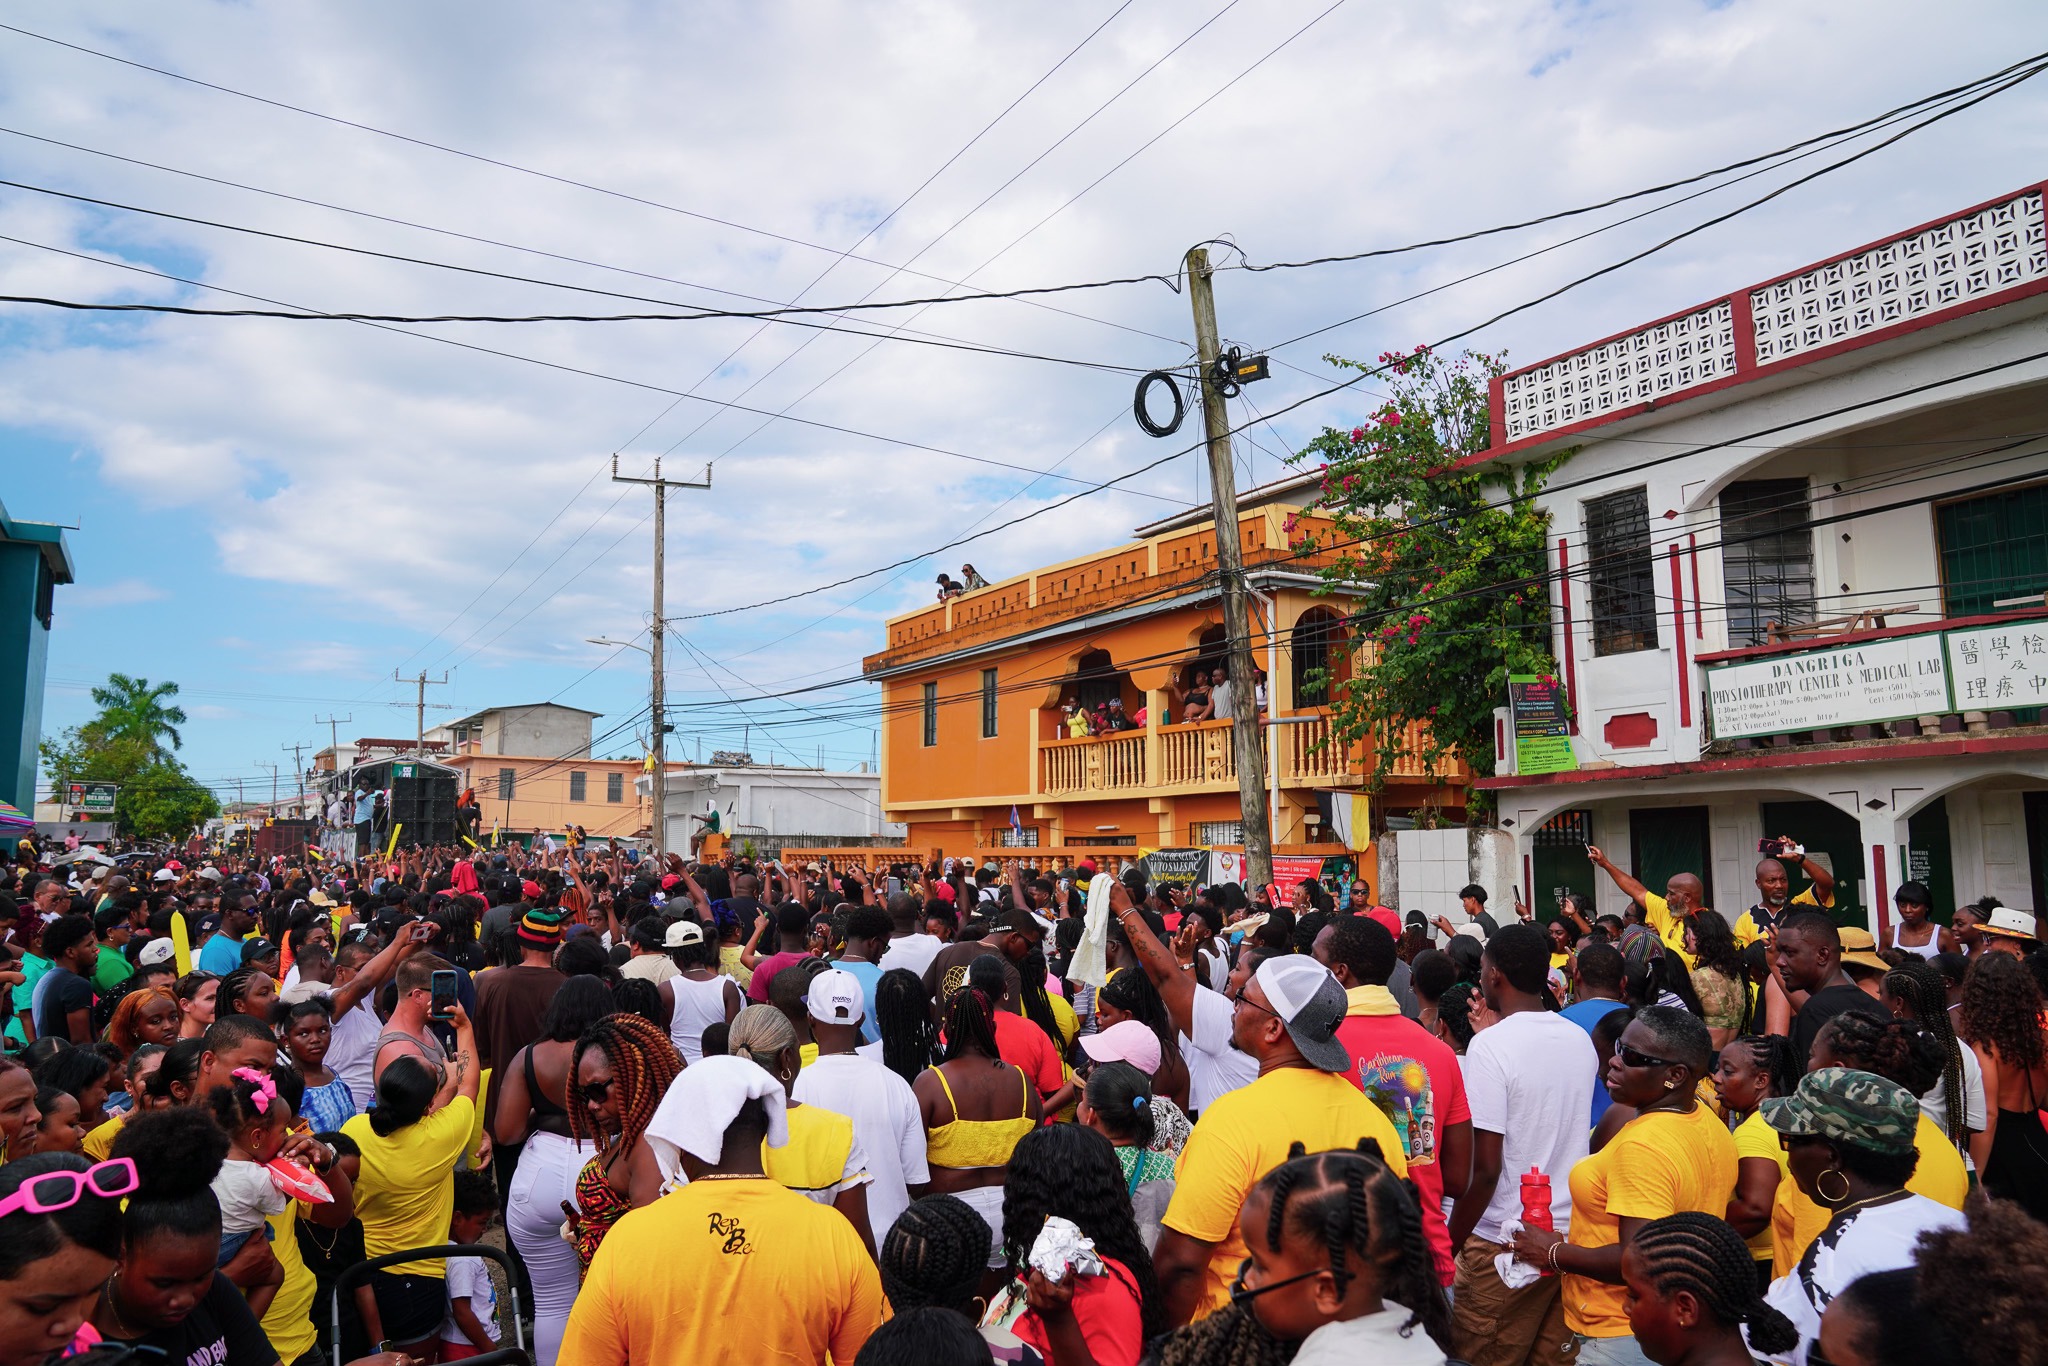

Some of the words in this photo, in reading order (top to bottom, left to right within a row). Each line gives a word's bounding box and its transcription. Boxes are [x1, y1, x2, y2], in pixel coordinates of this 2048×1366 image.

[1772, 651, 1865, 678] DANGRIGA
[1712, 680, 1793, 705] PHYSIOTHERAPY
[1799, 673, 1840, 692] CENTER
[1846, 672, 1854, 685] &
[1860, 663, 1911, 684] MEDICAL
[1918, 658, 1941, 676] LAB
[1744, 720, 1775, 730] Vincent
[1780, 716, 1807, 725] Street
[1358, 1051, 1404, 1076] Caribbean
